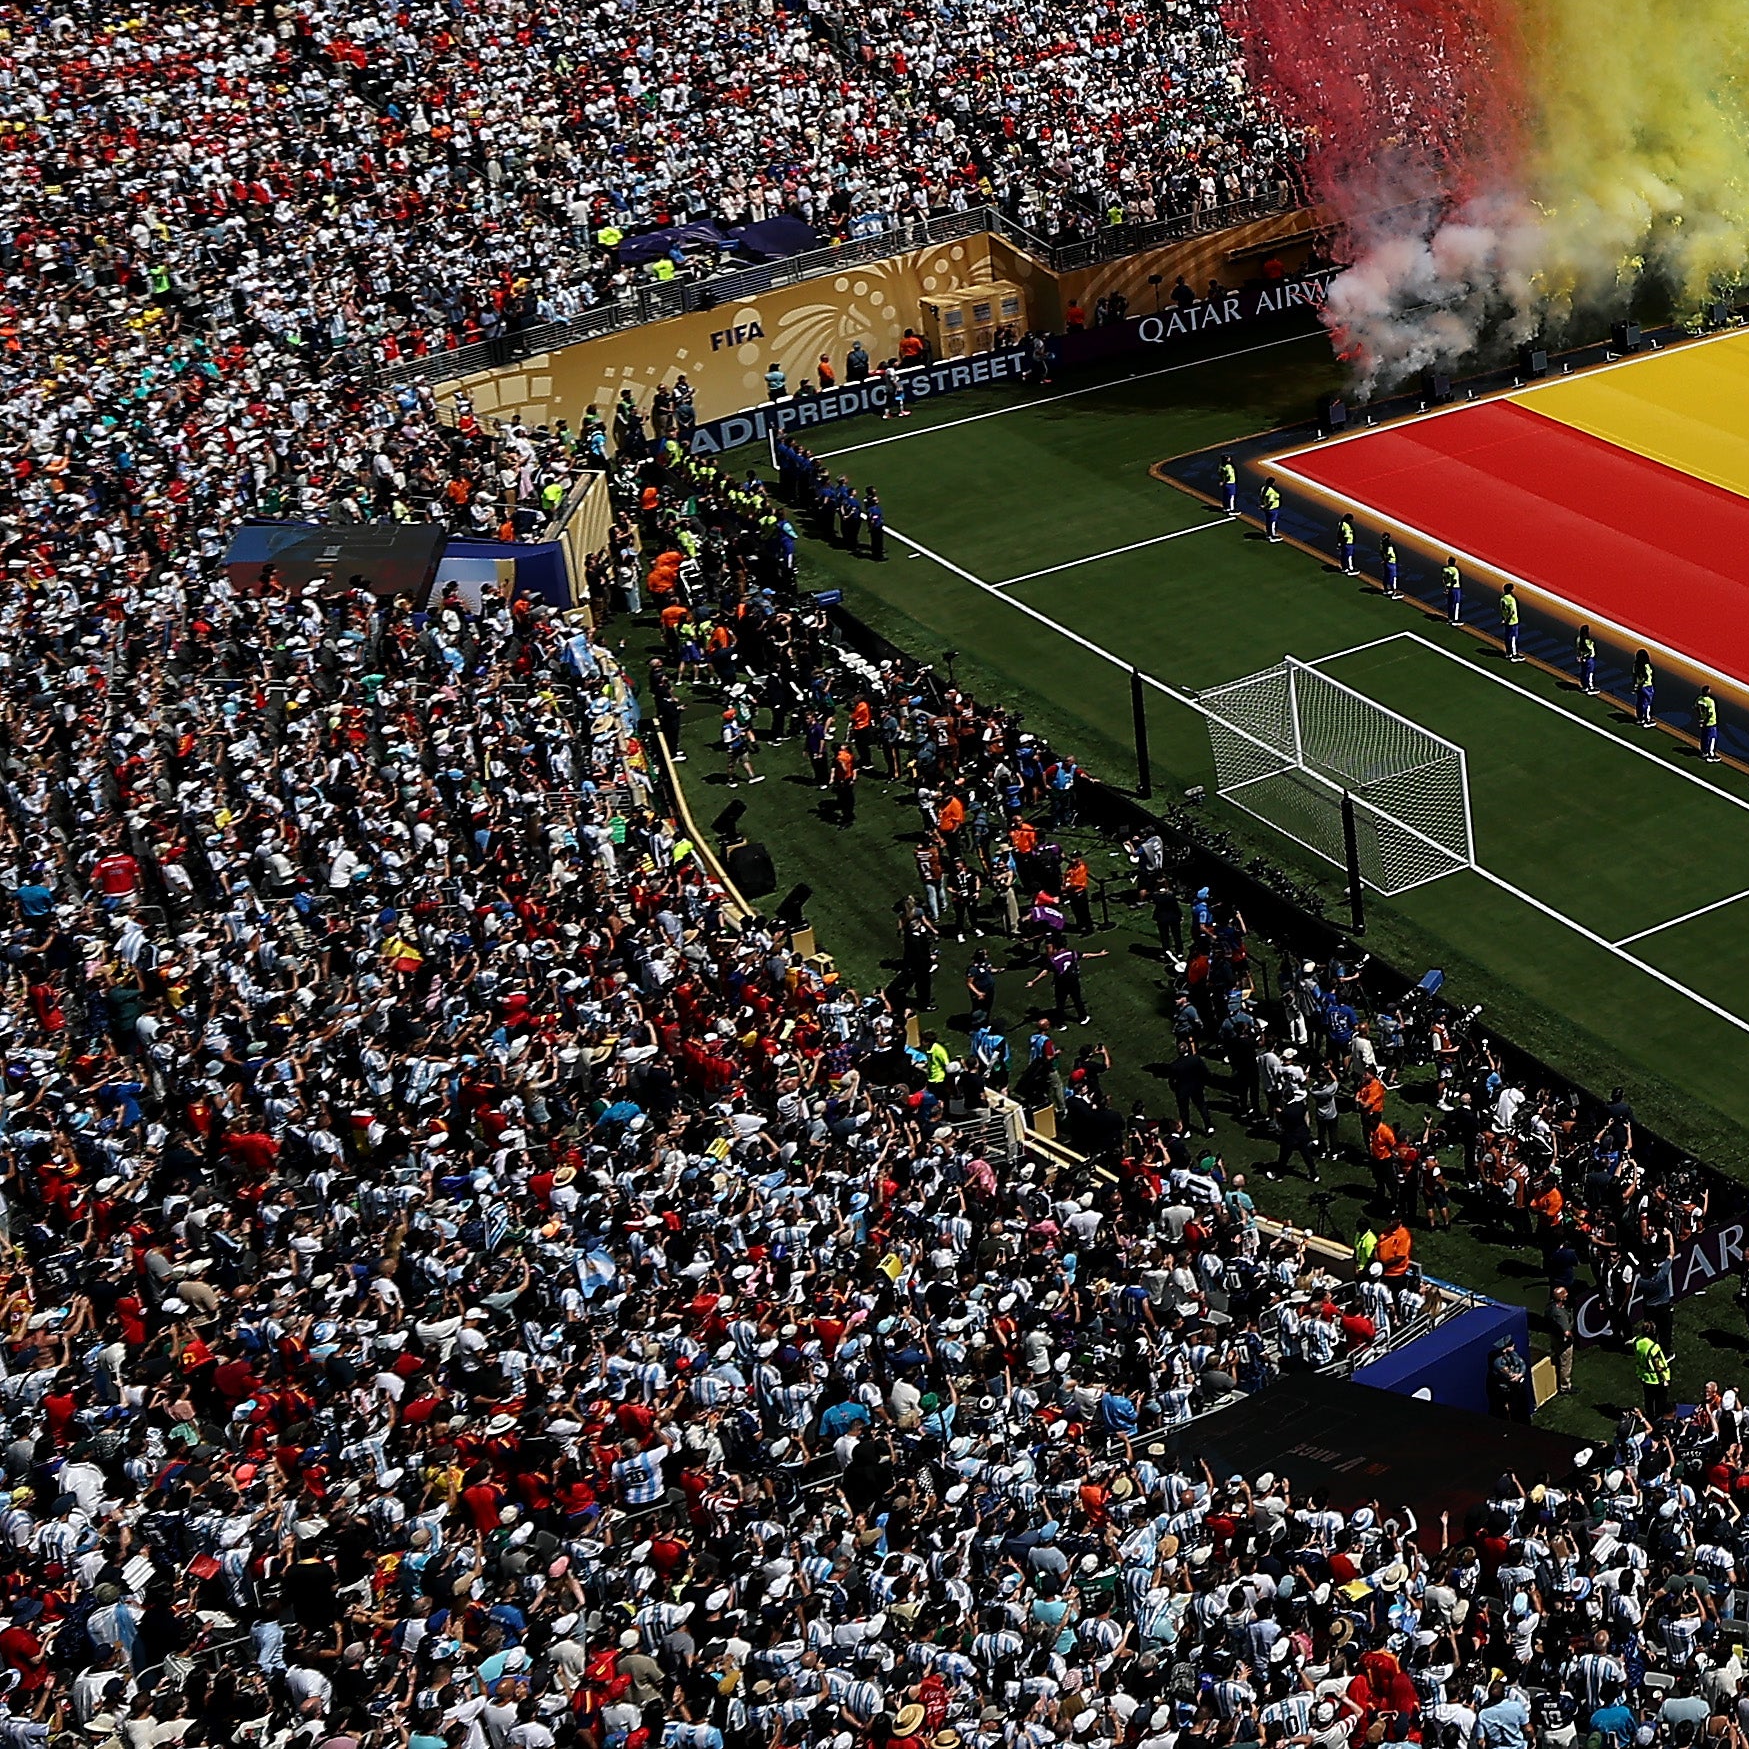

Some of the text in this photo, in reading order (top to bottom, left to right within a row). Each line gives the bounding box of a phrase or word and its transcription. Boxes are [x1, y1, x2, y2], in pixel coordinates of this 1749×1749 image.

[709, 320, 766, 353] FIFA
[1138, 274, 1334, 344] QATAR AIRW
[777, 351, 1026, 428] PREDICSTREET
[690, 408, 767, 454] ADI
[1577, 1224, 1745, 1340] QTAR
